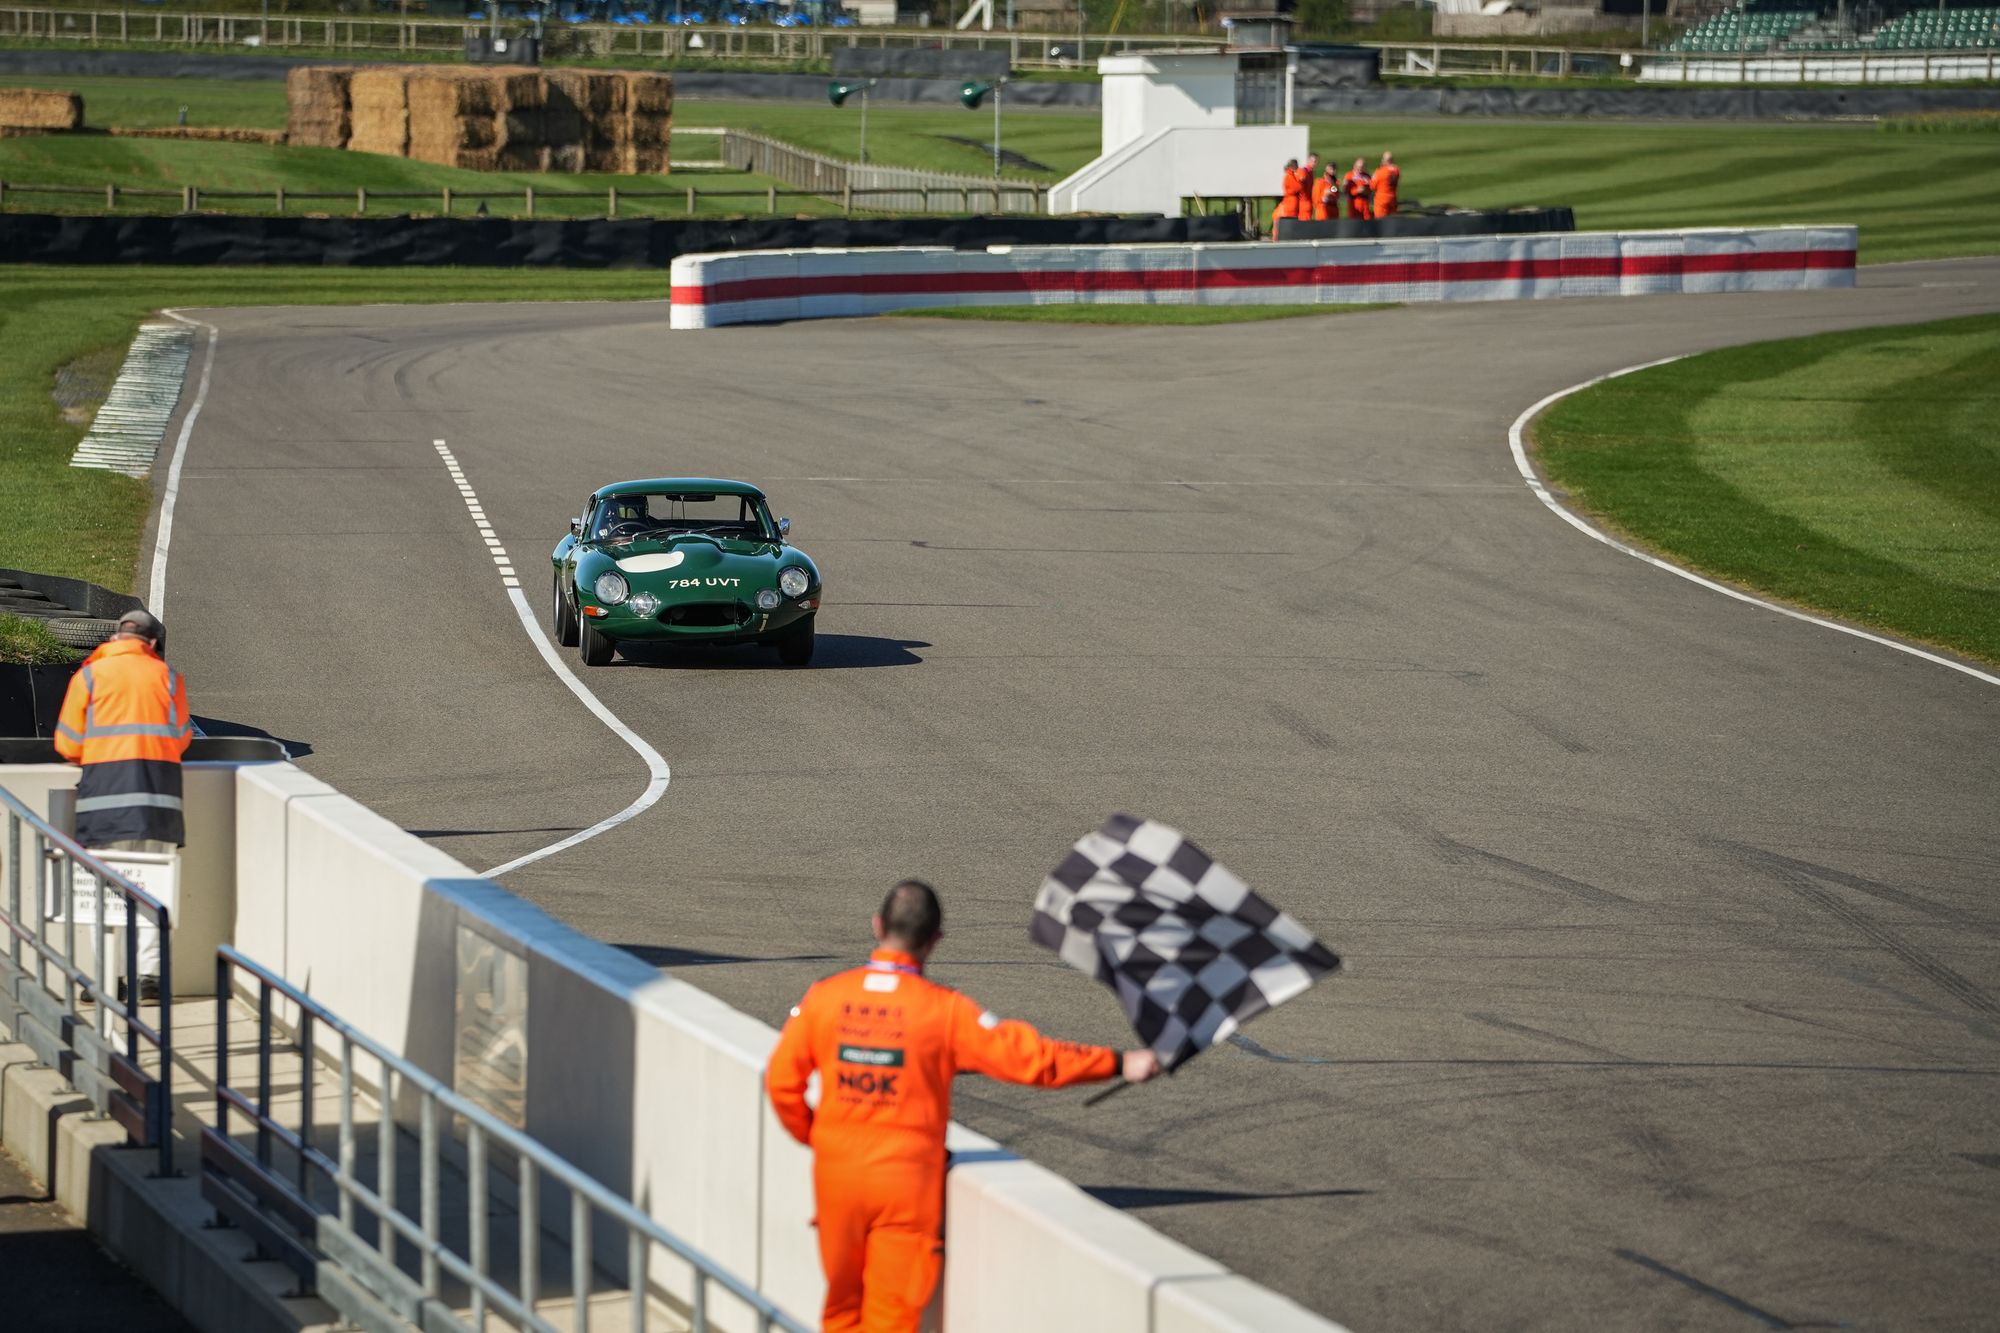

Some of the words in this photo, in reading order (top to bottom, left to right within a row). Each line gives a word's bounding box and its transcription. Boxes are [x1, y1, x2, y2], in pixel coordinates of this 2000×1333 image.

[669, 578, 700, 589] 784
[705, 578, 741, 587] UVT
[837, 1072, 898, 1096] NGK
